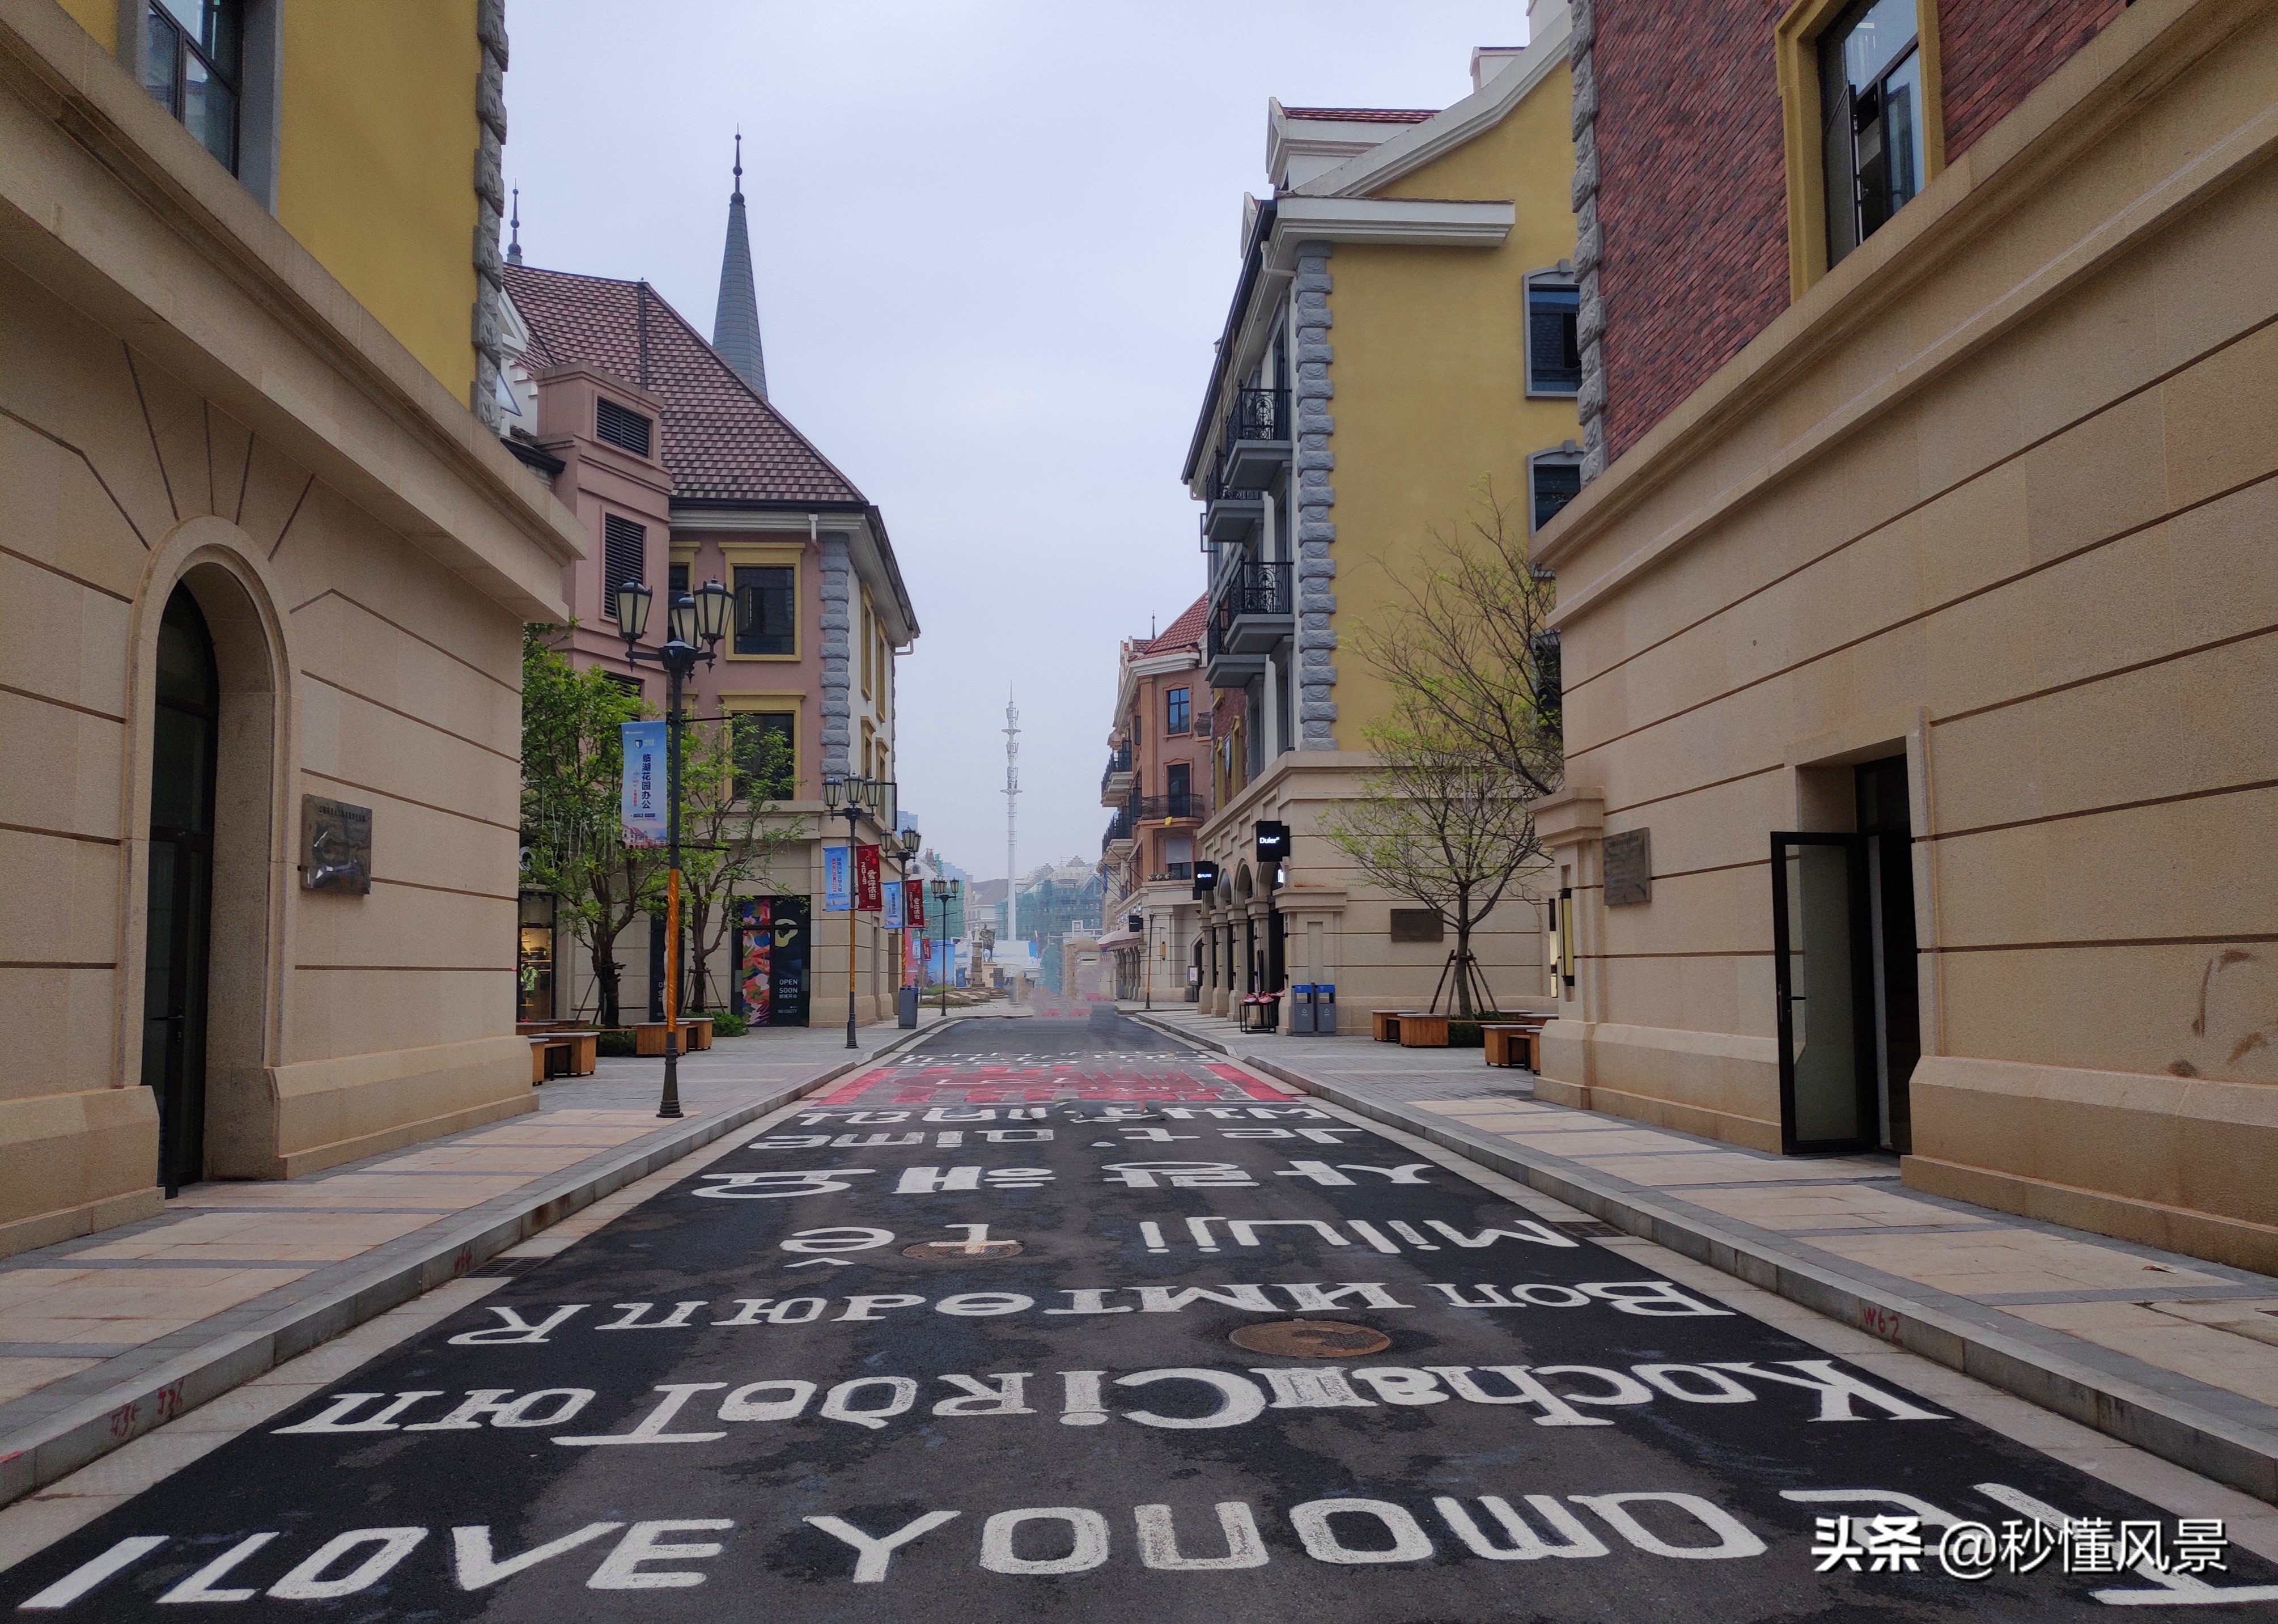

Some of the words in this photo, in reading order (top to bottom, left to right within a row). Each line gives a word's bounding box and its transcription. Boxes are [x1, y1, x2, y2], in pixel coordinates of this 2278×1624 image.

[641, 753, 652, 809] 临湖花园办公
[867, 870, 877, 900] 爱你依旧
[18, 1534, 170, 1609] I
[156, 1518, 735, 1604] LOVE
[801, 1500, 1271, 1584] YOU
